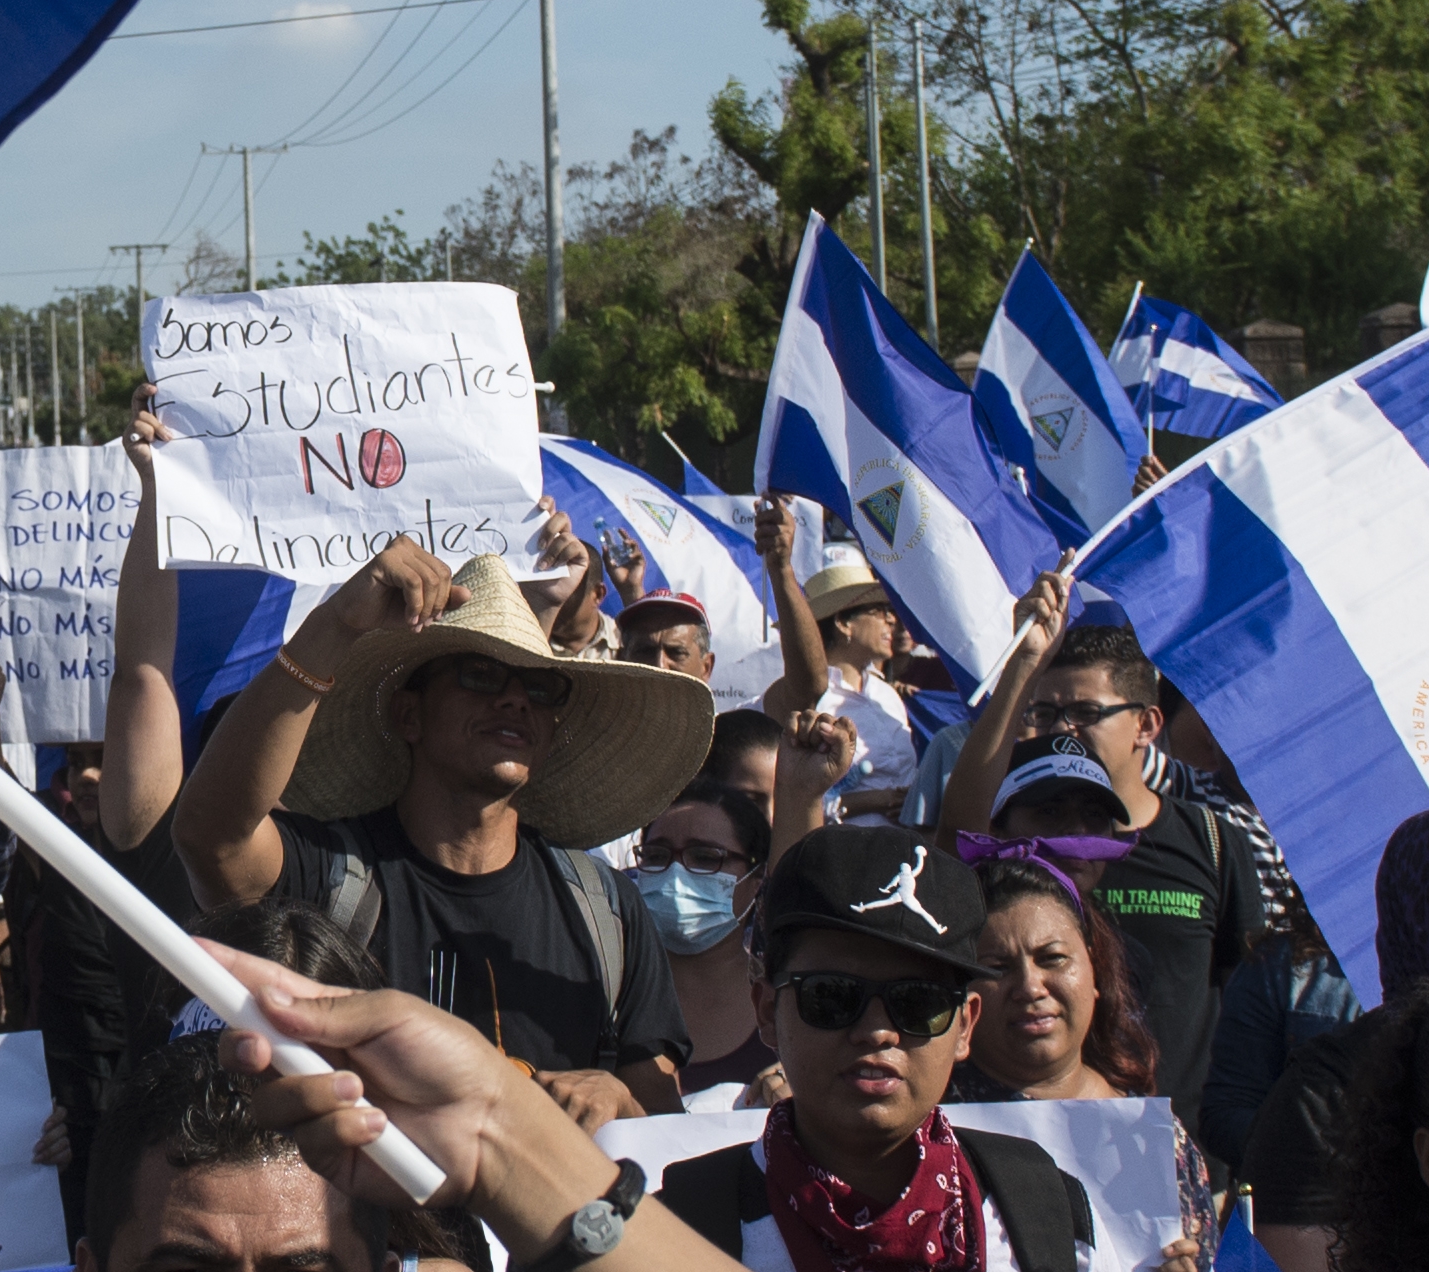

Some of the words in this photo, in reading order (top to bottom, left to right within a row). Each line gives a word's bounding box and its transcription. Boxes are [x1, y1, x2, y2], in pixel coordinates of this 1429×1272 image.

[155, 307, 292, 359] Somos
[299, 427, 407, 495] NO
[11, 488, 141, 516] SOMOS
[8, 521, 133, 547] DELINCU
[58, 554, 120, 590] MÁS
[54, 602, 112, 637] MÁS
[5, 657, 41, 683] NO
[59, 646, 110, 681] MÁS
[1107, 889, 1124, 904] IN
[1128, 889, 1202, 909] TRAINING
[1120, 904, 1160, 915] BETTER
